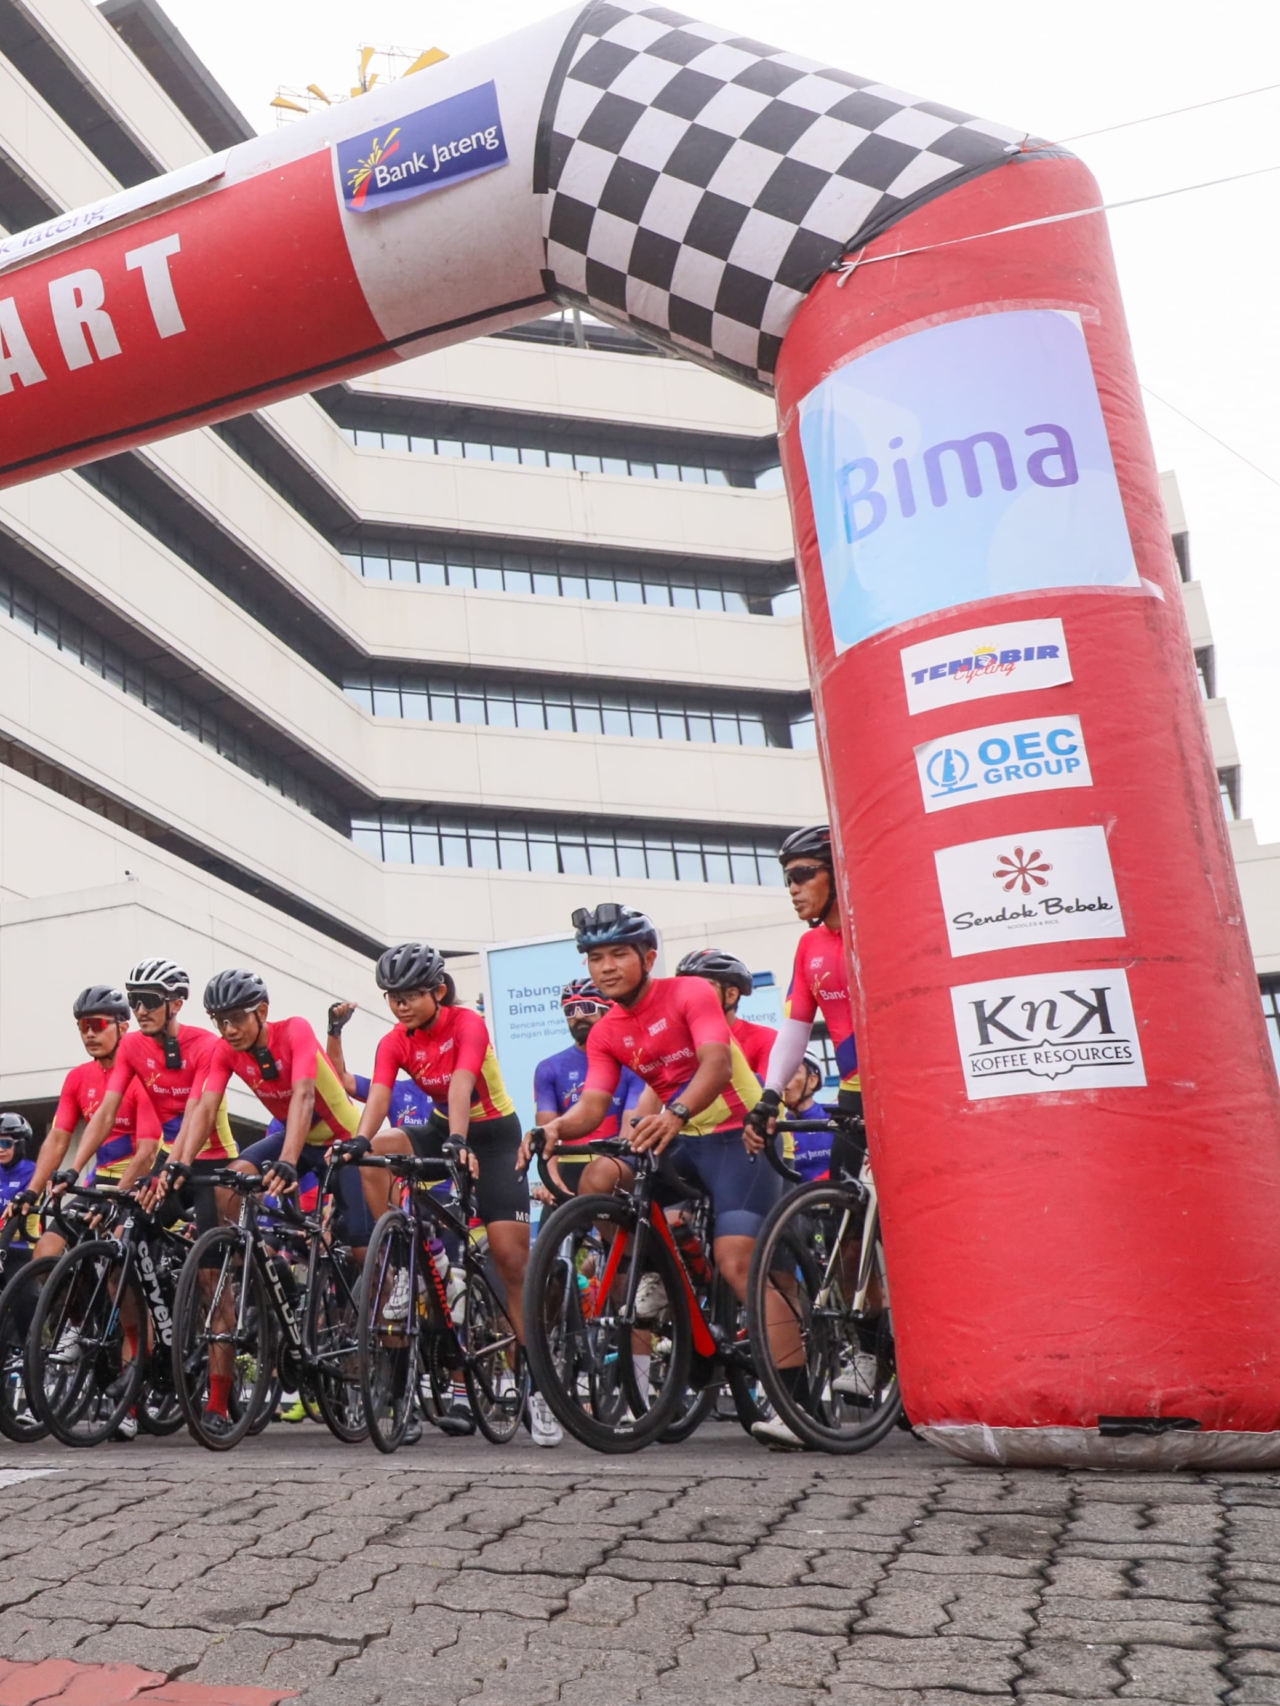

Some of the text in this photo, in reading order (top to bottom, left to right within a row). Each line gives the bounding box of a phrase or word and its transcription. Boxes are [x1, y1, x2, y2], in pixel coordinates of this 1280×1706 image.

[374, 126, 500, 188] Bank Jateng
[835, 423, 1080, 544] Bima
[953, 660, 1017, 684] Cycling
[978, 728, 1078, 766] OEC
[983, 757, 1081, 785] GROUP
[952, 896, 1113, 930] Sendok Bebek
[1008, 921, 1037, 930] NOODLES
[509, 1003, 545, 1015] Bima
[510, 1021, 545, 1030] Rencana
[510, 1031, 542, 1039] dengan
[971, 1046, 1132, 1072] KOFFEE RESOURCES
